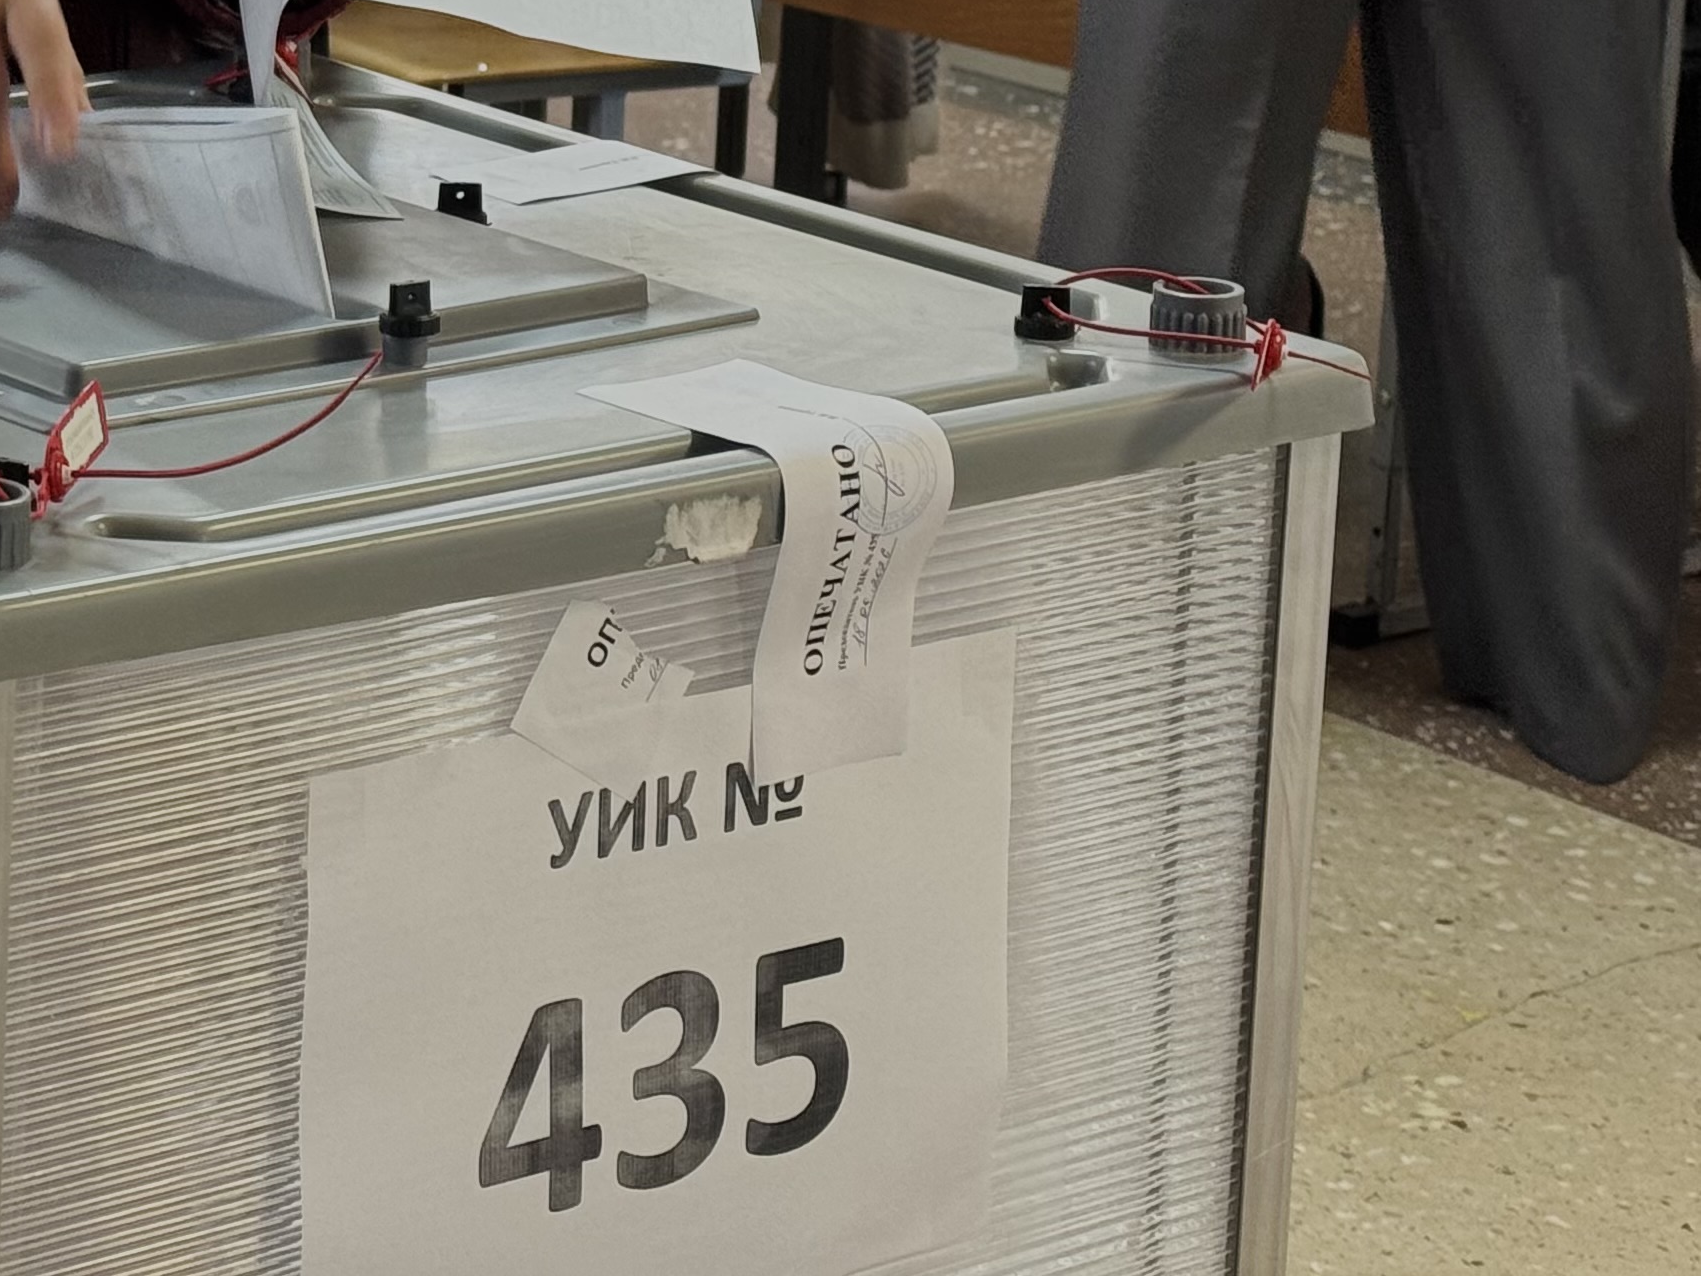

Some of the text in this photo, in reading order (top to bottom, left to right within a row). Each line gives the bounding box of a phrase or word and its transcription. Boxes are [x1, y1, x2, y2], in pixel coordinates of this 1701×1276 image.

[587, 607, 623, 668] ОП
[802, 443, 860, 677] ОПЕЧАТАНО
[548, 770, 699, 870] УИК
[478, 935, 851, 1213] 435
